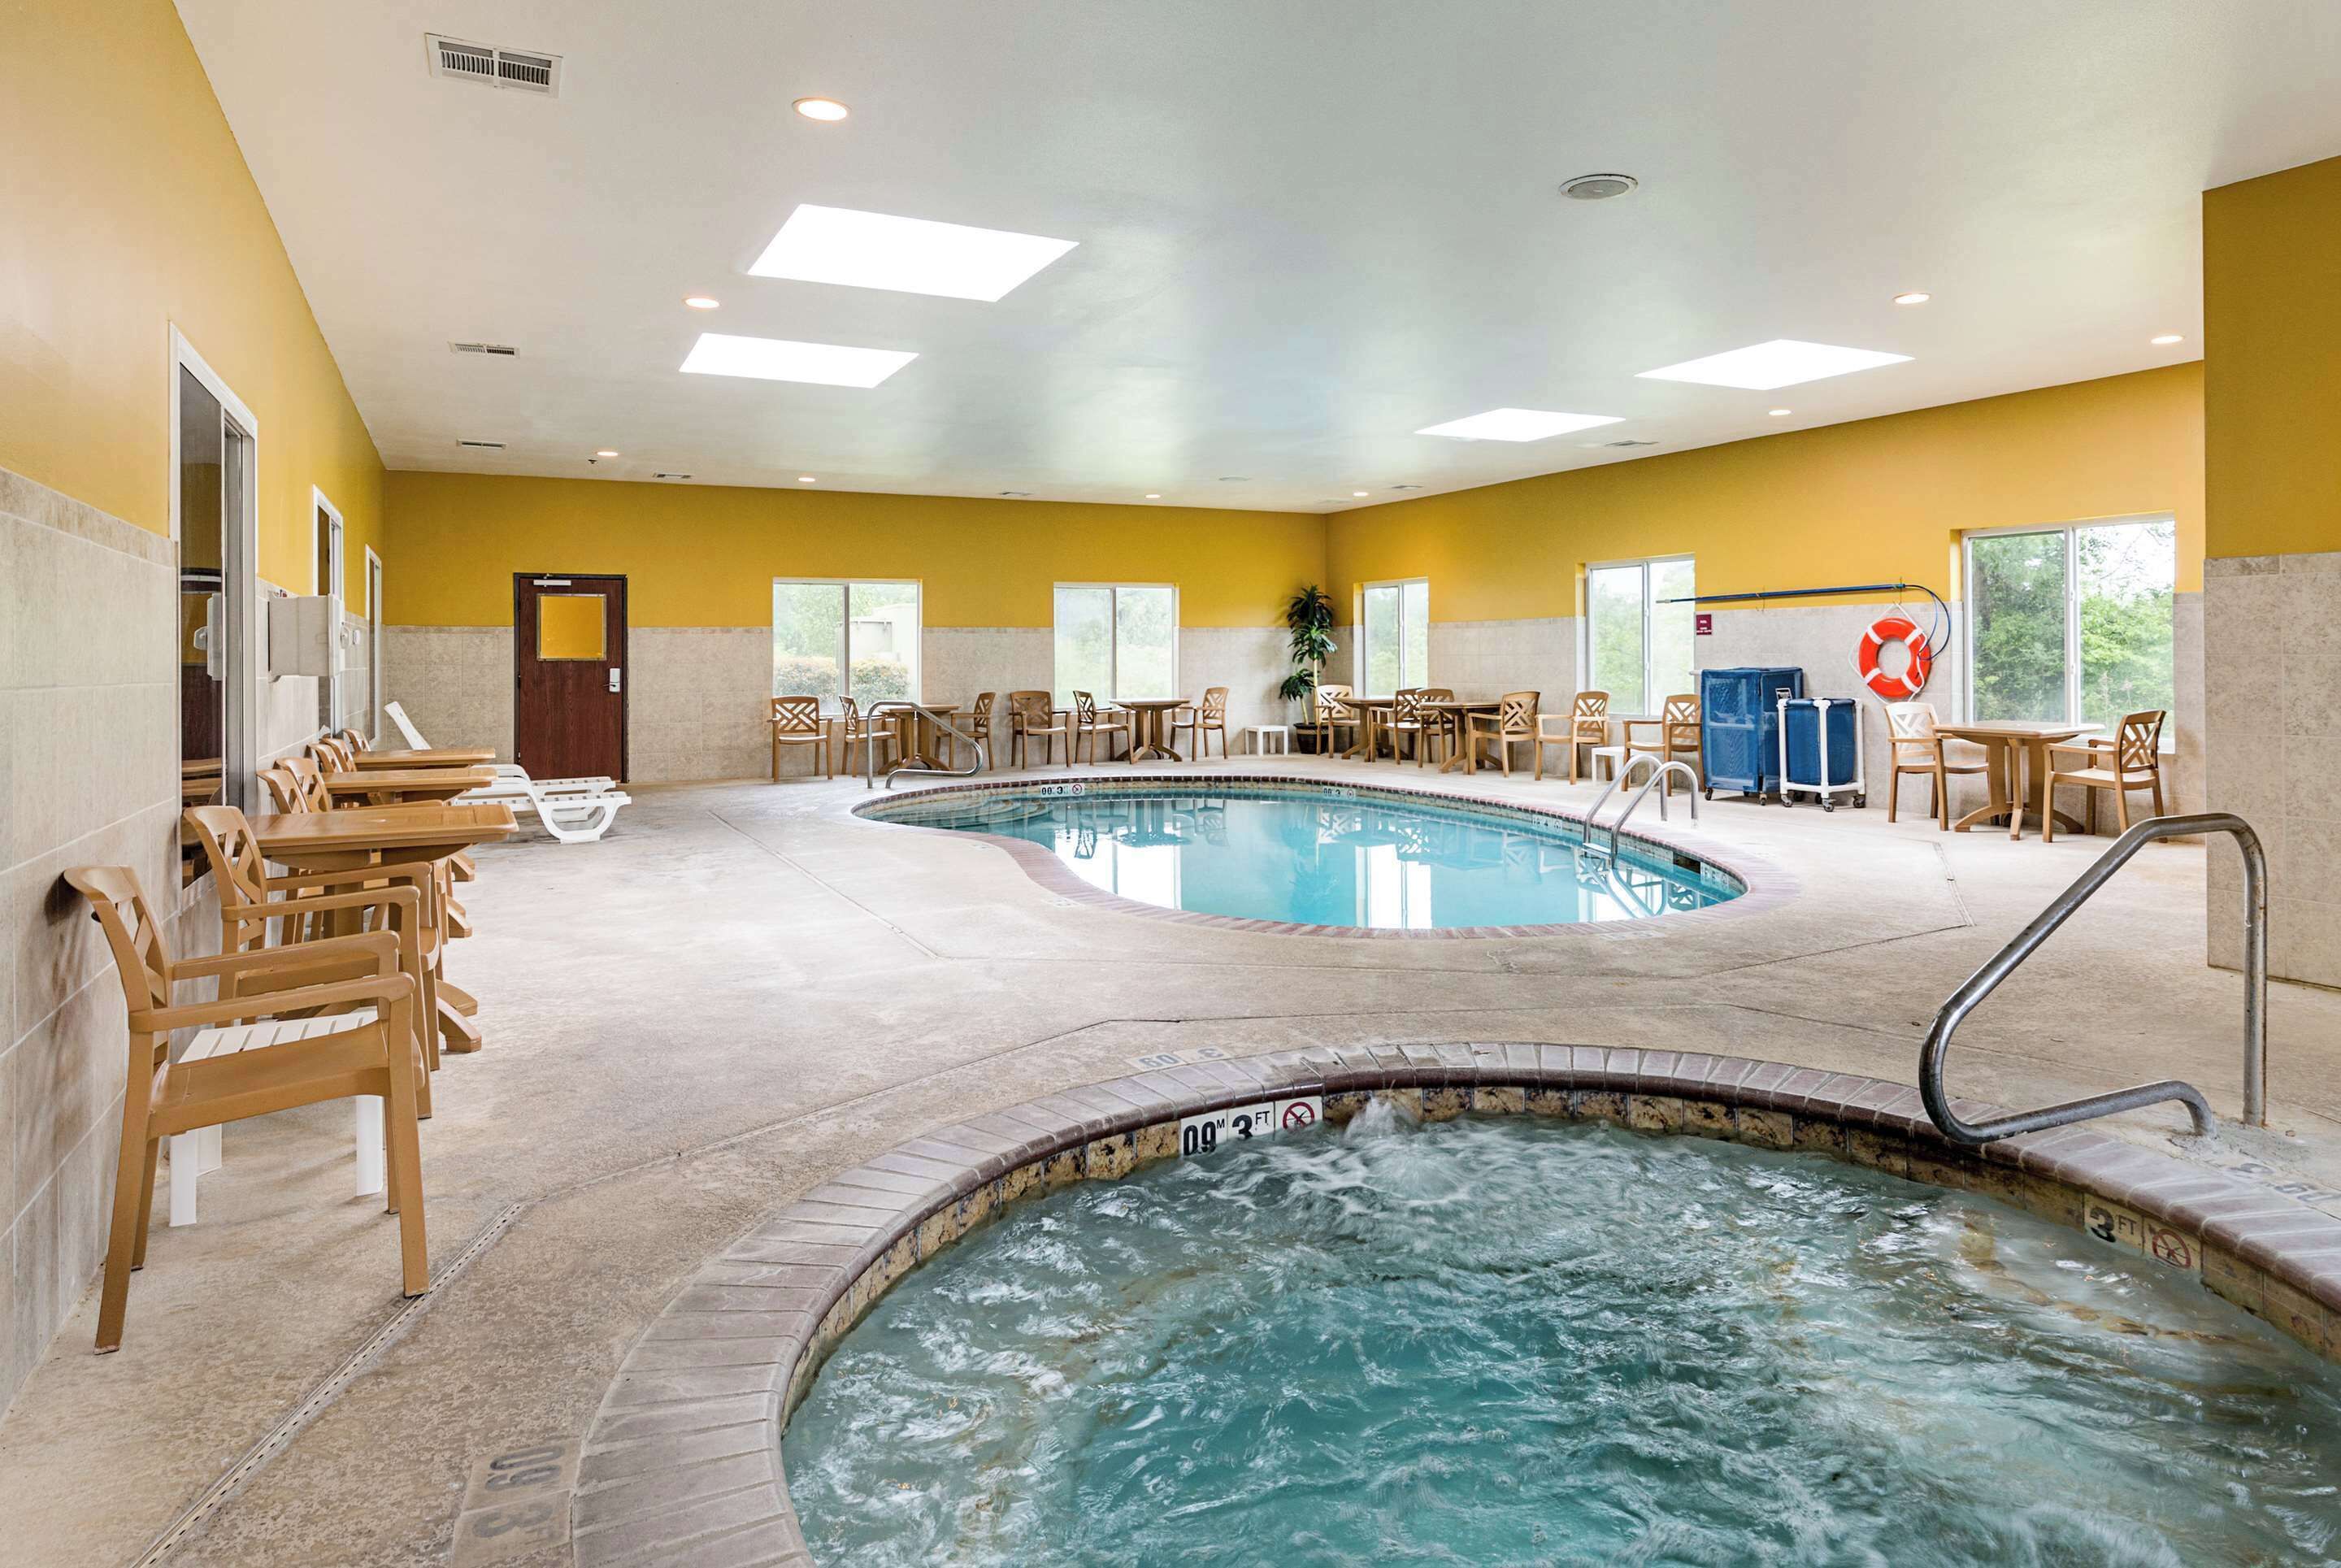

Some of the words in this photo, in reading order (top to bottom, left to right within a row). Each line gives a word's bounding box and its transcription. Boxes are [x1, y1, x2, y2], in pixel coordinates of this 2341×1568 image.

[1232, 1114, 1253, 1140] 3
[1255, 1110, 1270, 1125] FT
[2090, 1207, 2116, 1243] 3
[2118, 1214, 2137, 1236] FT
